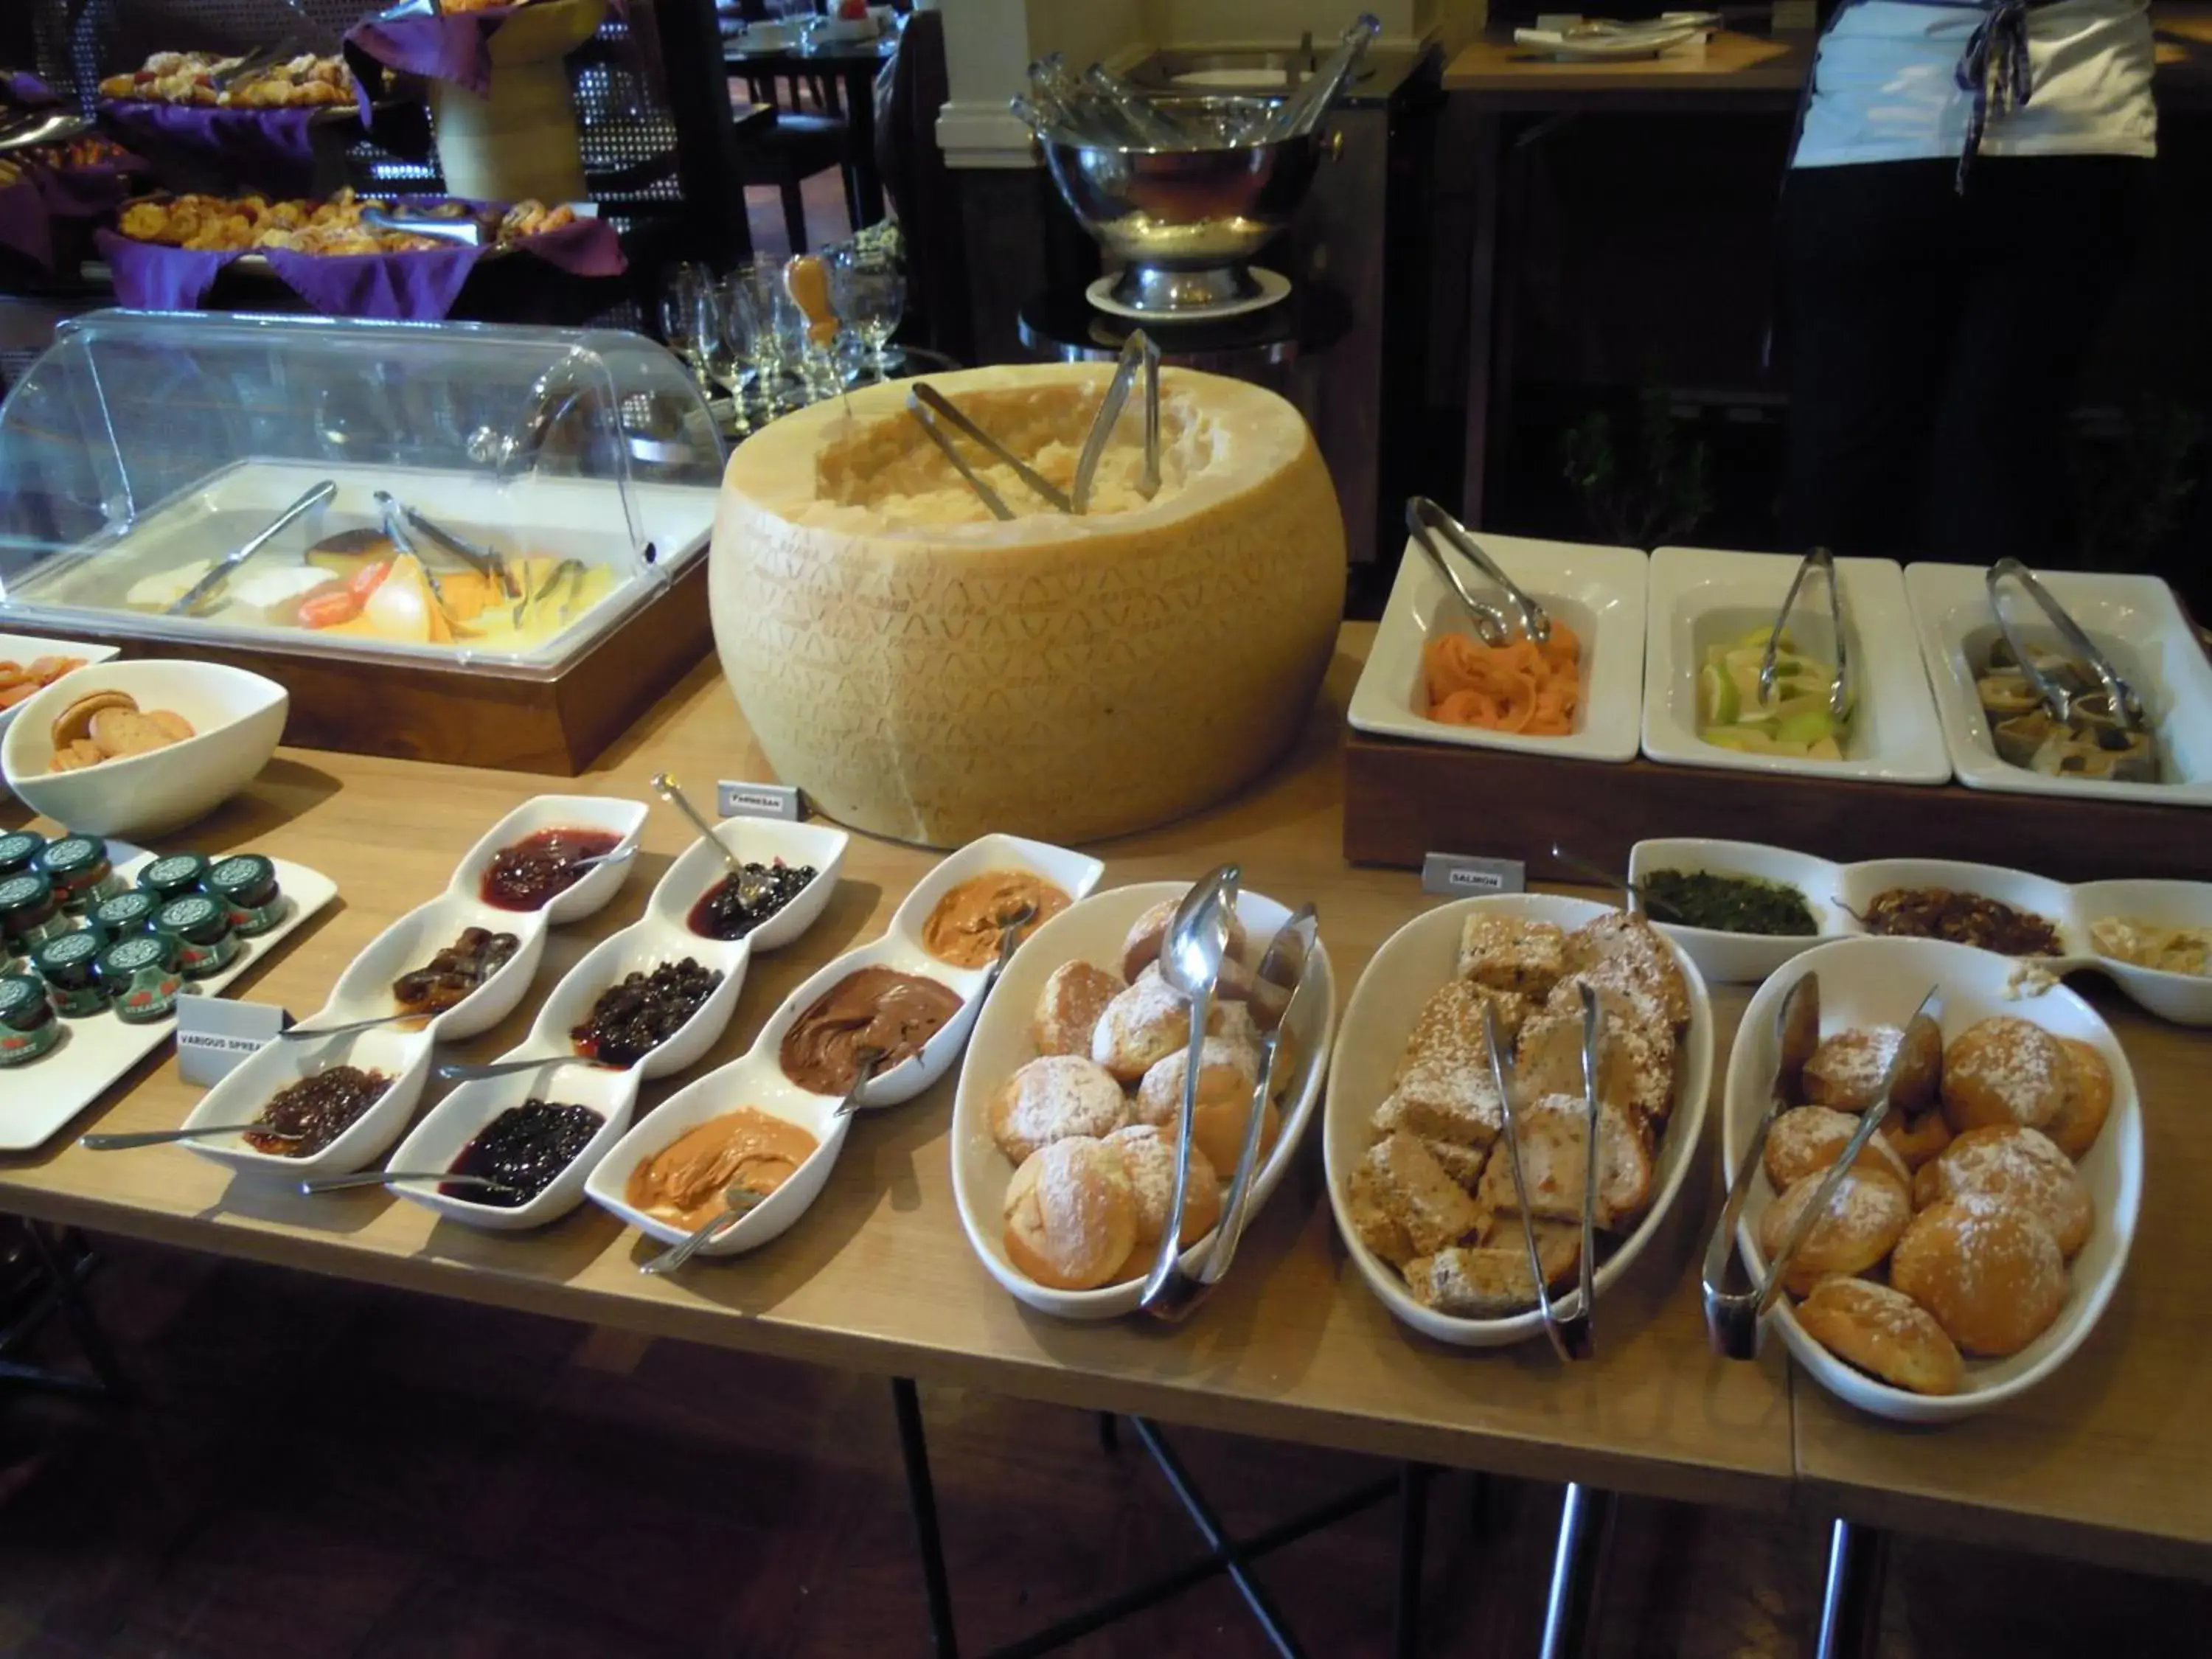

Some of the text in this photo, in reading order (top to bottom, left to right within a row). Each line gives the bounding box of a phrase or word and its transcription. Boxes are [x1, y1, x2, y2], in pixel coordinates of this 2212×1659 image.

[1452, 873, 1498, 886] SALMON
[181, 1034, 262, 1051] VARIOUS SPREA
